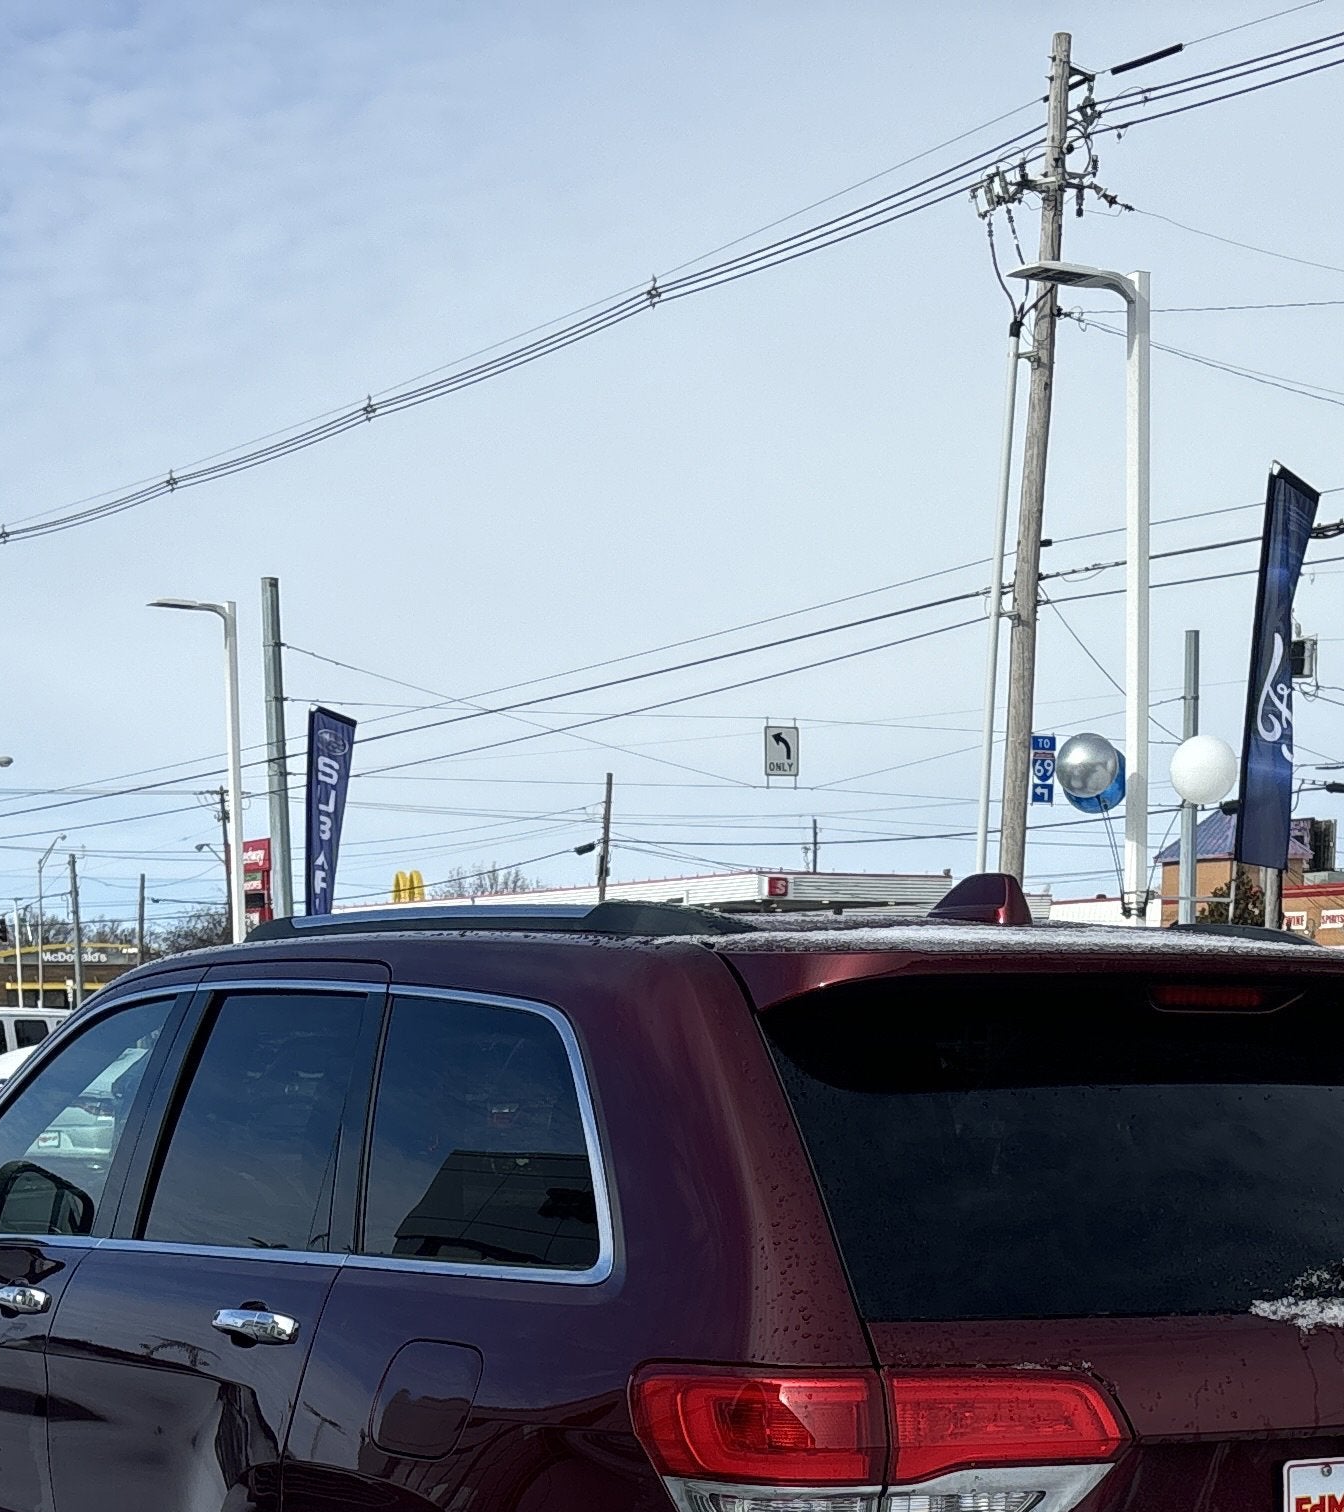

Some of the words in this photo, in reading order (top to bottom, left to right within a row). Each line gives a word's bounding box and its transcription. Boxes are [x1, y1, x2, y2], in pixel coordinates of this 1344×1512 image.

[1037, 738, 1051, 749] TO
[768, 761, 794, 772] ONLY
[1035, 759, 1054, 777] 69
